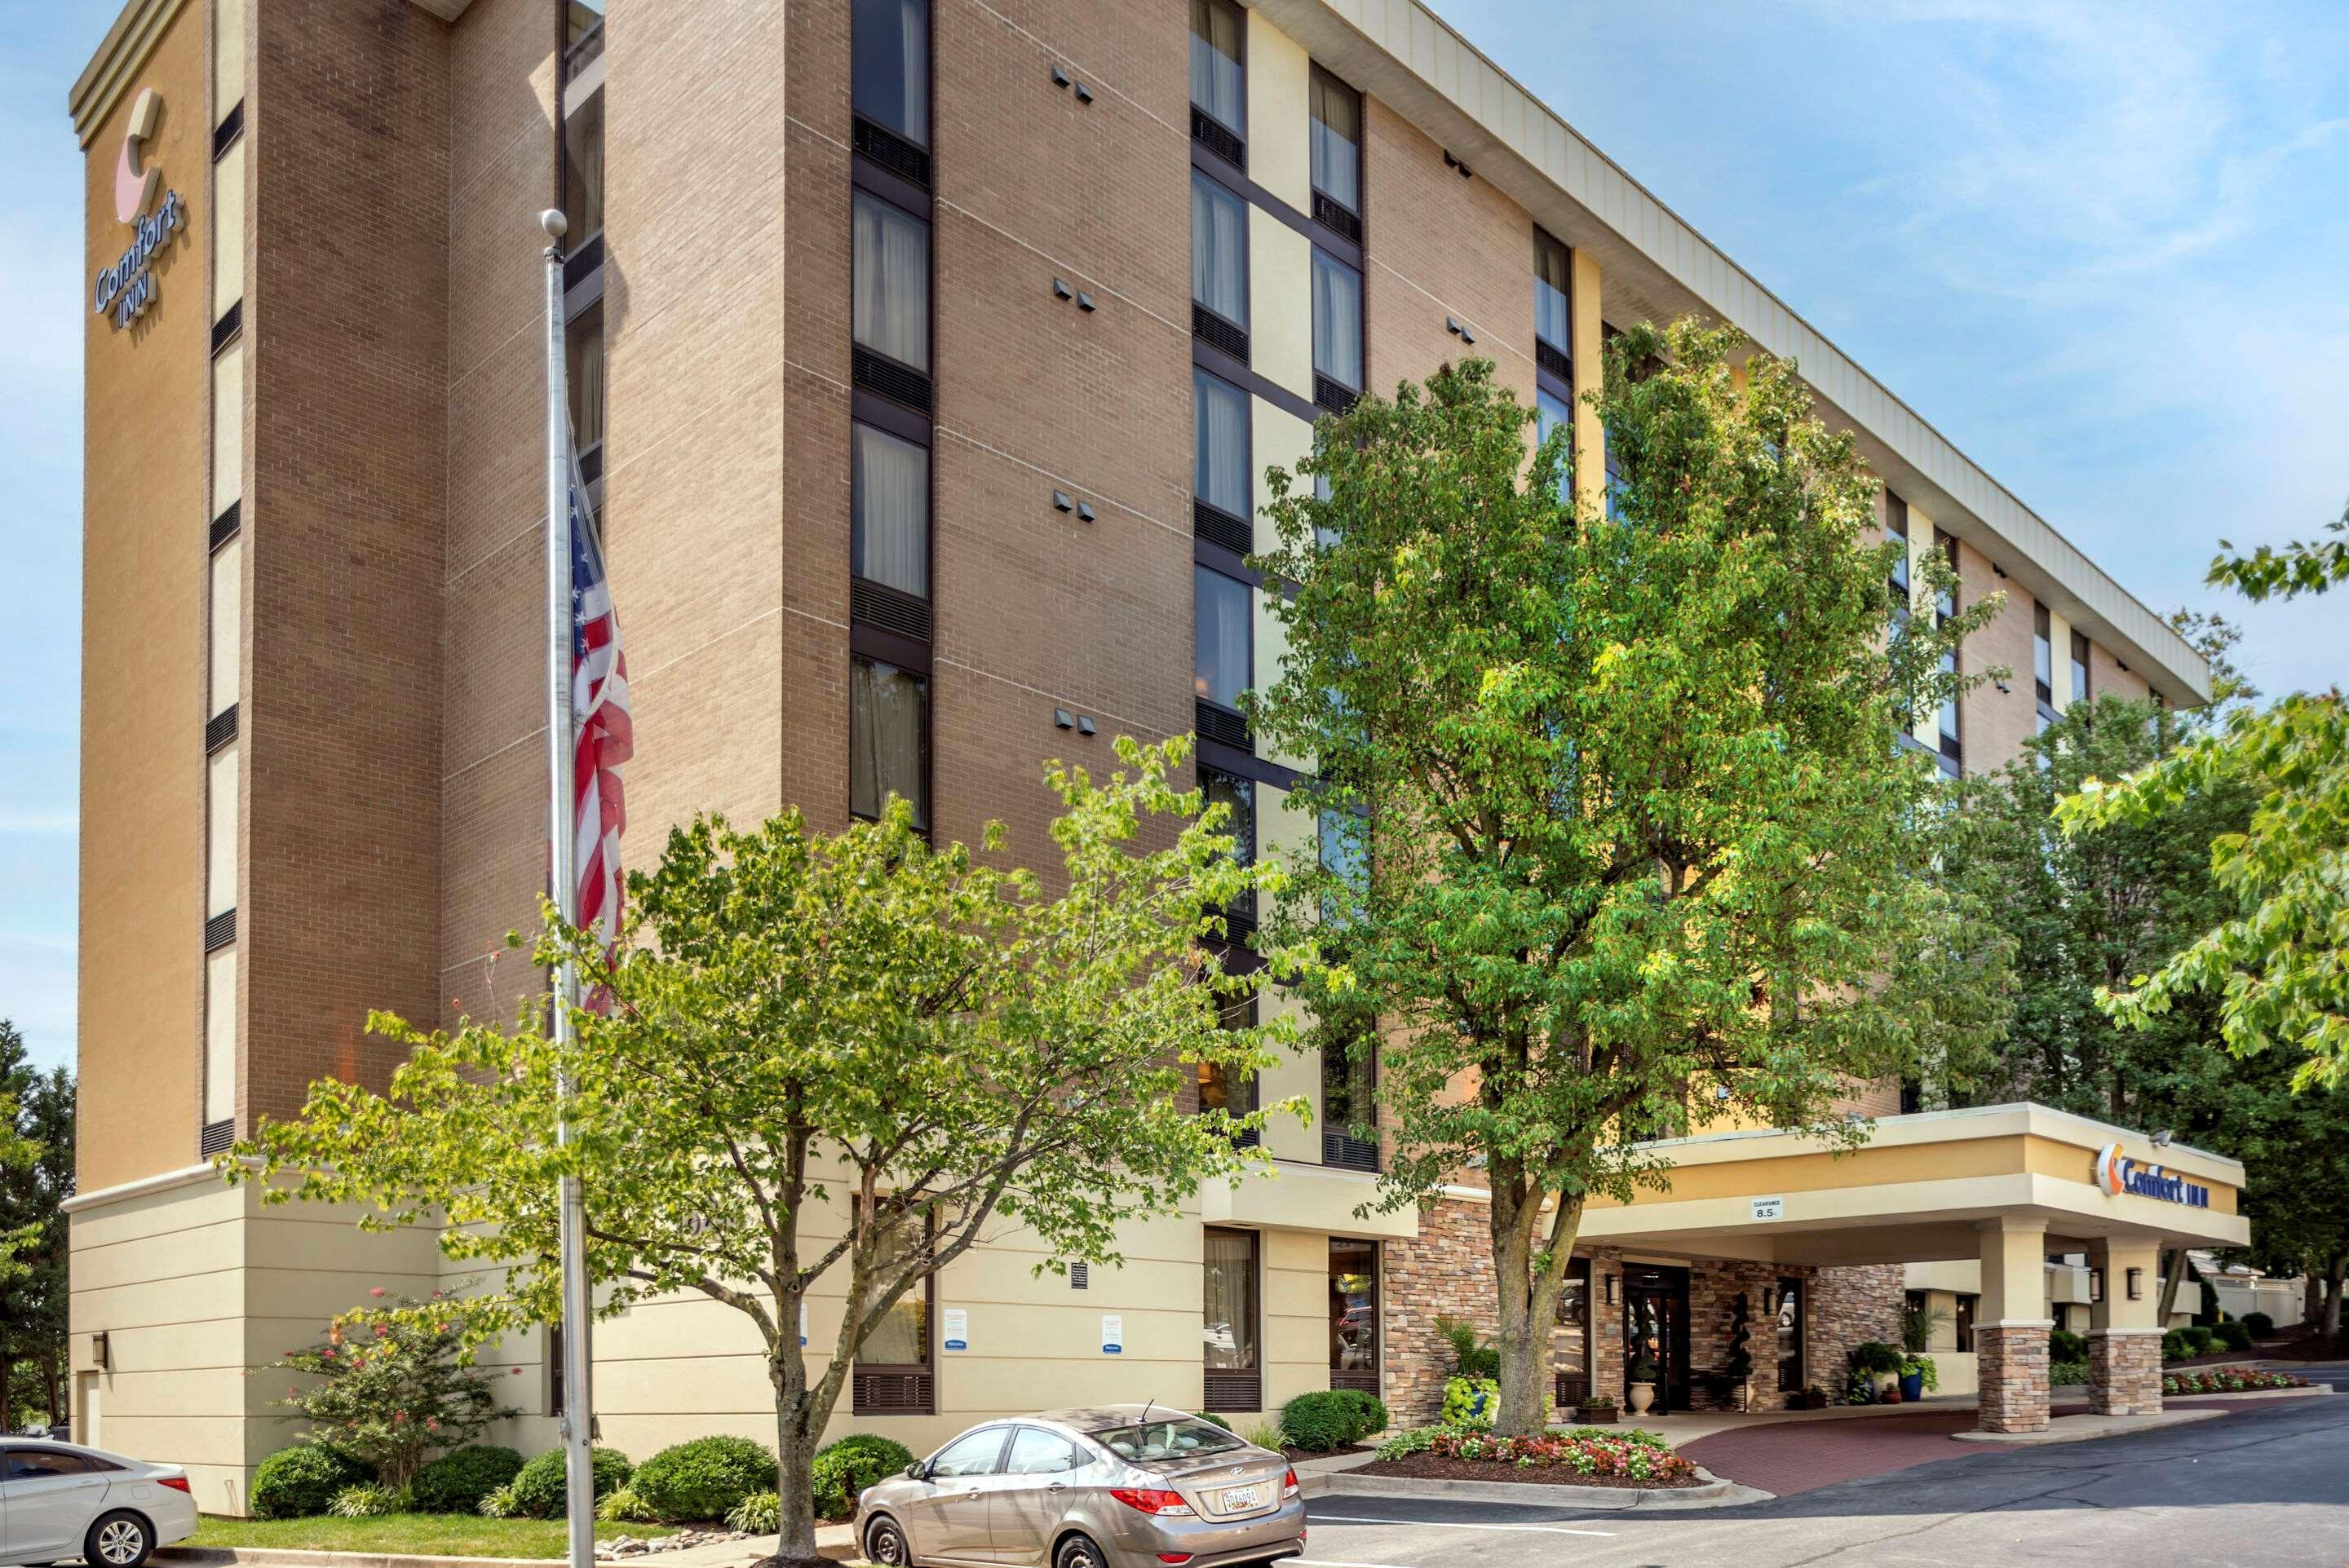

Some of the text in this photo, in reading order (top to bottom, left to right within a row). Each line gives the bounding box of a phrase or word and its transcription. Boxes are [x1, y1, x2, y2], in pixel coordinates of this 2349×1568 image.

[95, 189, 176, 314] Comfort
[117, 272, 148, 328] INN
[2123, 1159, 2183, 1203] Comfort
[1757, 1208, 1773, 1217] 8.5
